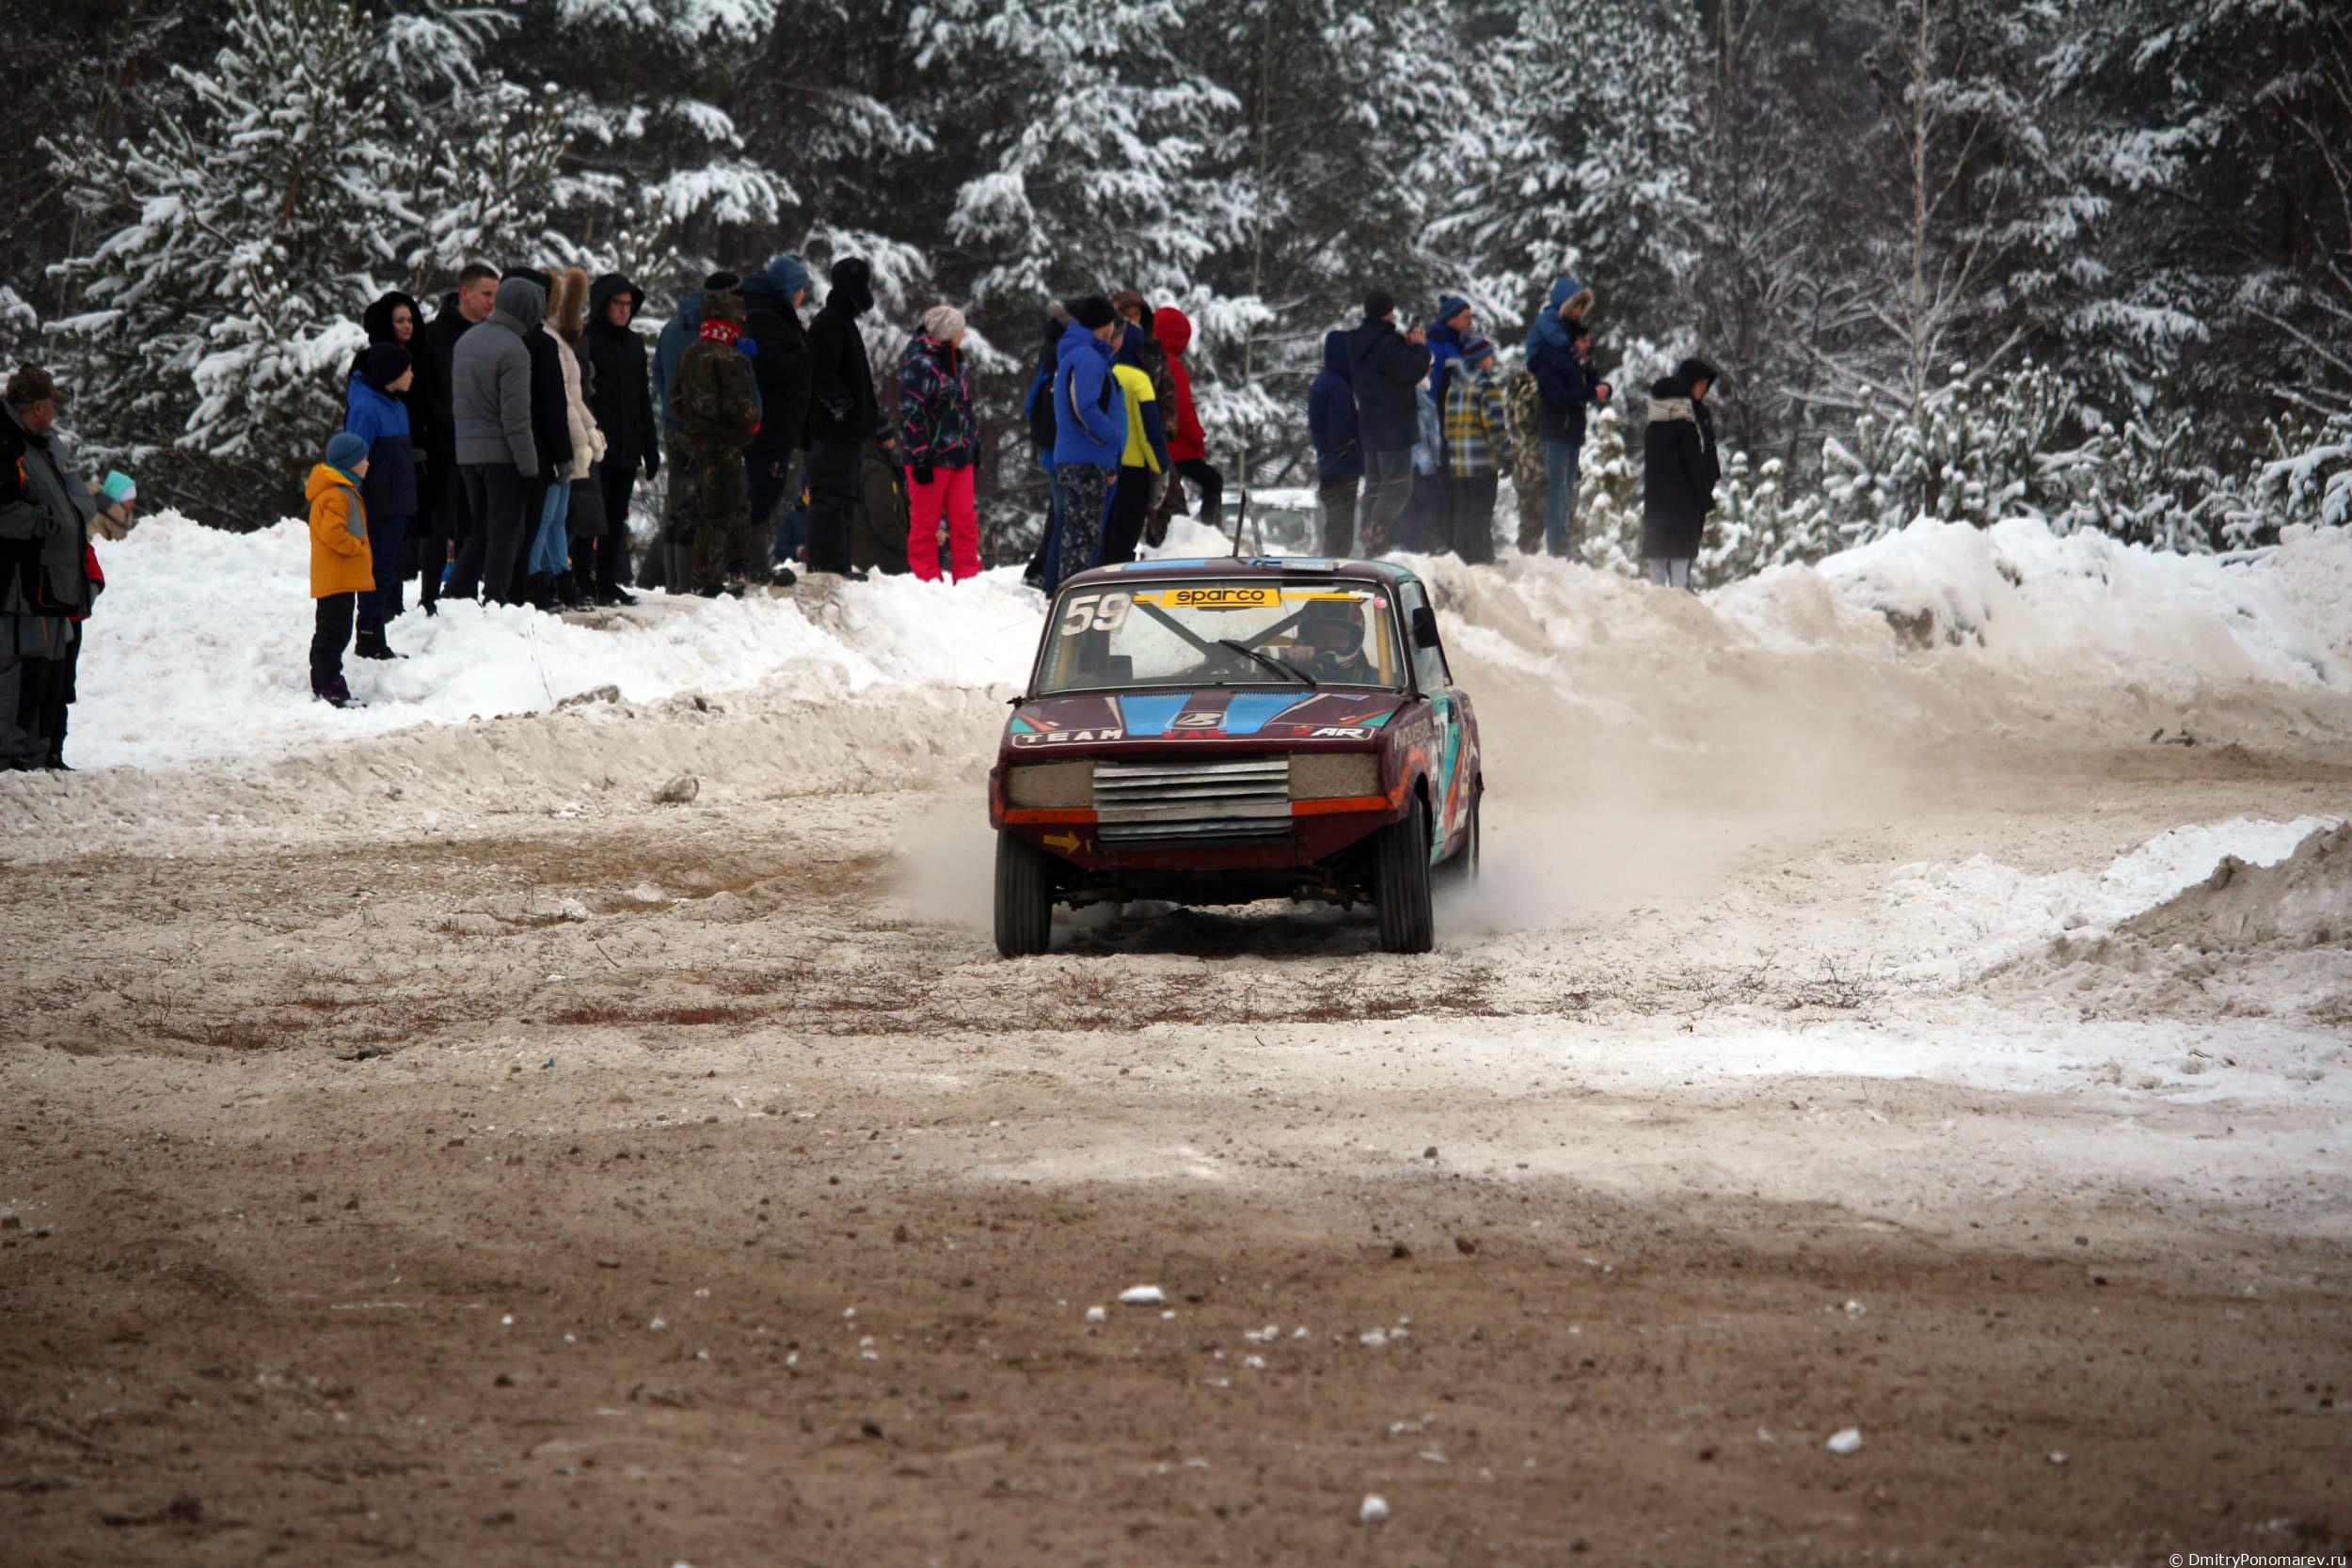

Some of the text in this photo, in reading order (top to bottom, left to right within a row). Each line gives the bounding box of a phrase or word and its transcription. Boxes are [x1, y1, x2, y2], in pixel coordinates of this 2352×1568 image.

[1175, 589, 1266, 606] sparco
[1061, 593, 1129, 637] 59
[1022, 729, 1124, 744] TEAM
